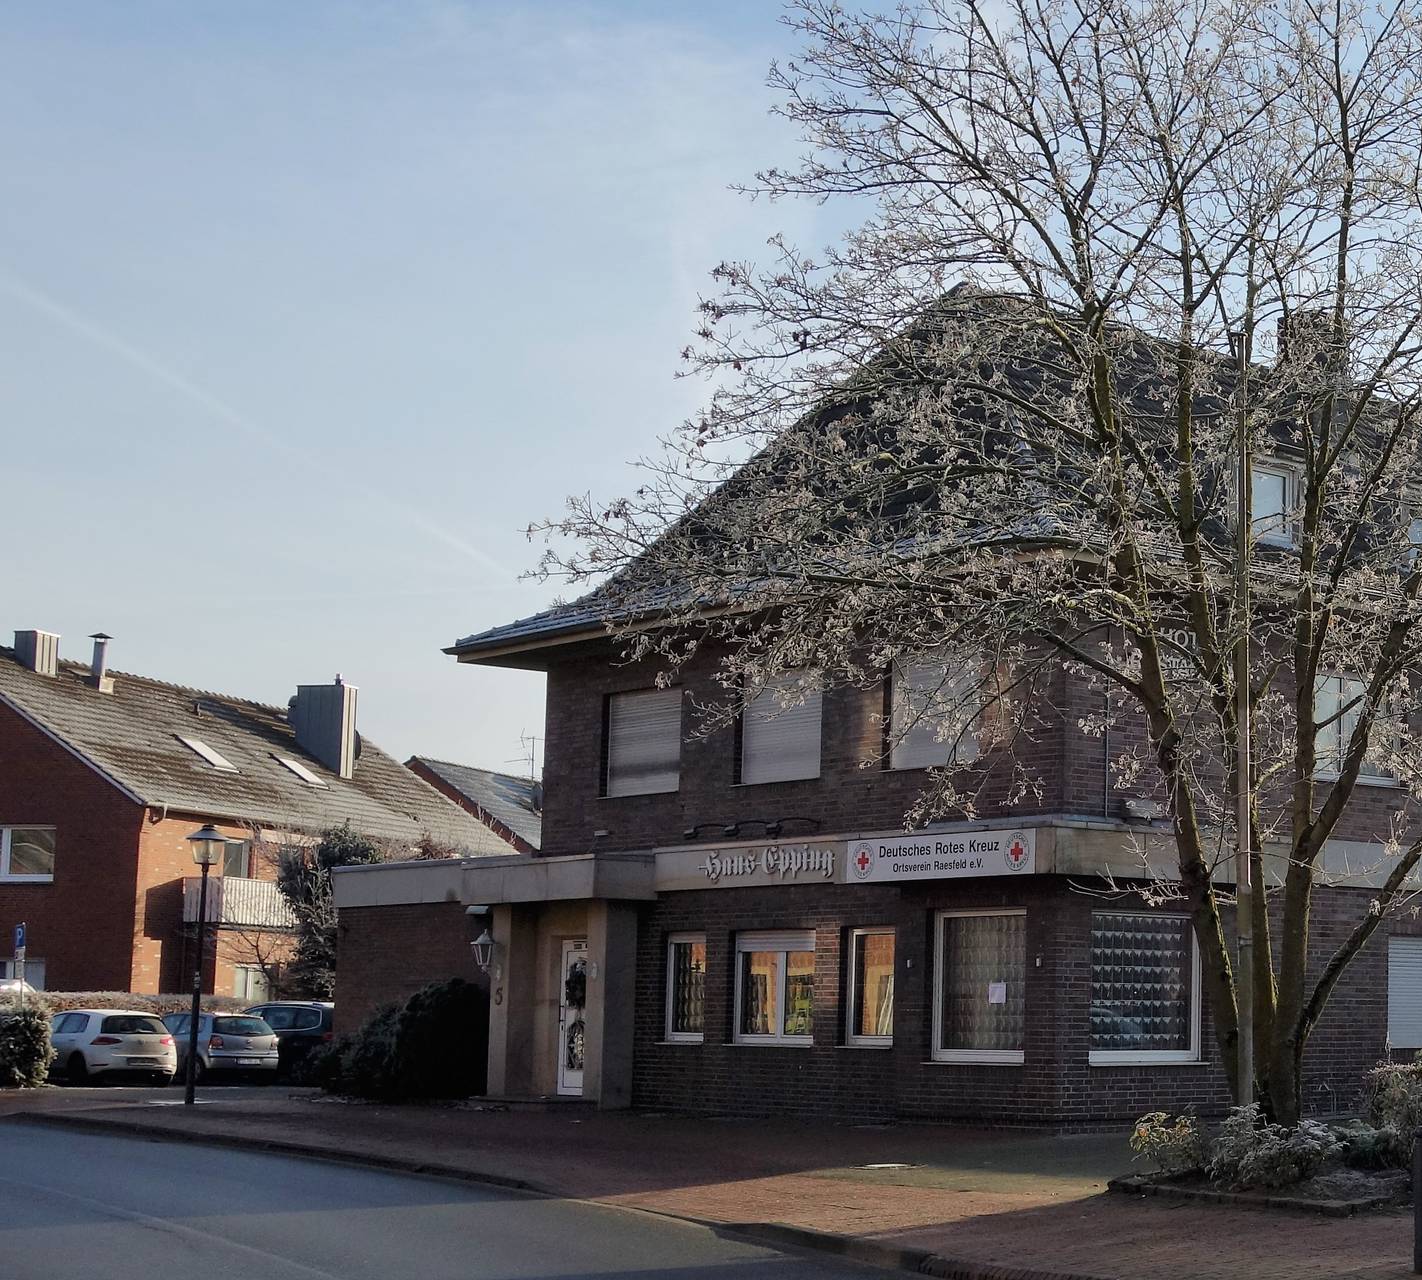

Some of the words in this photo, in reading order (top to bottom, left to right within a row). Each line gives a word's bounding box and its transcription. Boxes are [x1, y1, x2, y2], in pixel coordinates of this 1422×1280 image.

[879, 843, 931, 858] Deutsches
[935, 841, 965, 855] Rotes
[968, 839, 1000, 853] Kreuz
[704, 850, 756, 883] Haus
[761, 844, 835, 879] Epping
[892, 861, 931, 873] Ortsverein
[933, 859, 967, 871] Raesfeld
[969, 858, 984, 869] e.V.
[16, 927, 24, 946] P
